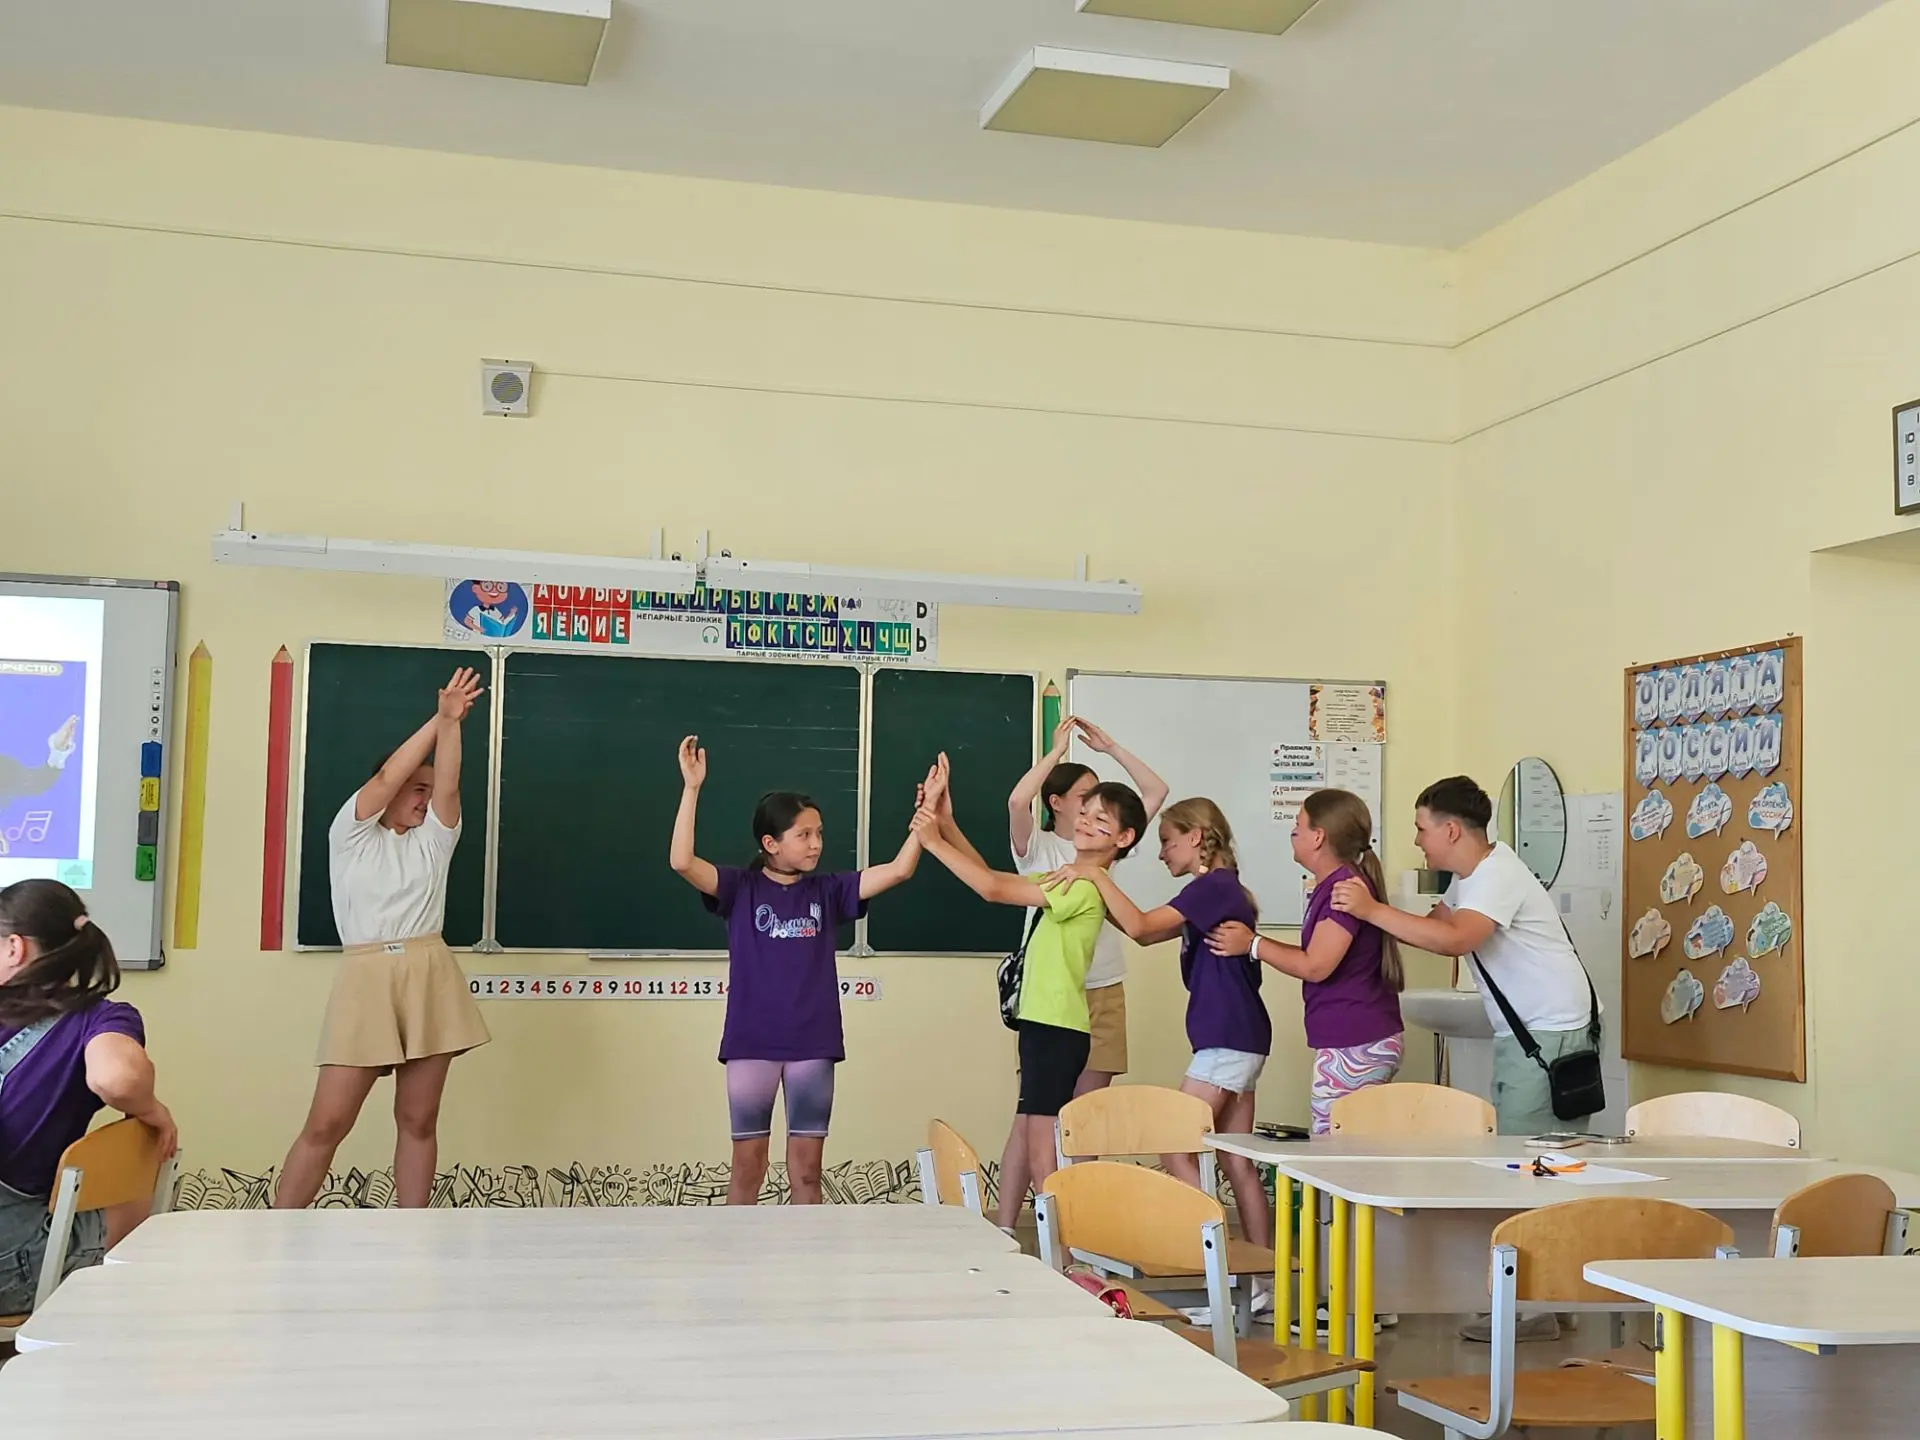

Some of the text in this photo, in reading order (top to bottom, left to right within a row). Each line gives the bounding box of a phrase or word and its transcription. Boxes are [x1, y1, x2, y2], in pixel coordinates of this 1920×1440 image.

[1905, 432, 1915, 444] 10
[1907, 453, 1914, 464] 9
[1907, 475, 1915, 486] 8
[694, 586, 705, 606] Л
[731, 590, 741, 608] Б
[750, 591, 760, 609] В
[786, 593, 798, 612] Д
[822, 596, 837, 612] Ж
[536, 610, 626, 638] Я Ё Ю И Е
[636, 613, 722, 624] НЕПАРНЫЕ ЗВОНКИЕ
[730, 622, 910, 652] П Ф К Т С Ш Х Ц Ч Щ
[736, 650, 766, 658] ПАРНЫЕ
[1640, 658, 1776, 704] ОРЛЯТА
[1641, 721, 1773, 763] РОССИИ
[470, 982, 480, 994] 0
[486, 982, 494, 994] 1
[500, 982, 510, 994] 2
[515, 982, 524, 994] 3
[530, 982, 541, 994] 4
[546, 982, 556, 994] 5
[562, 982, 572, 994] 6
[578, 982, 588, 994] 7
[592, 982, 602, 994] 8
[608, 982, 618, 994] 9
[624, 982, 642, 994] 10
[648, 982, 663, 994] 11
[670, 982, 688, 994] 12
[694, 982, 712, 994] 13
[717, 982, 730, 994] 1
[855, 982, 874, 995] 20
